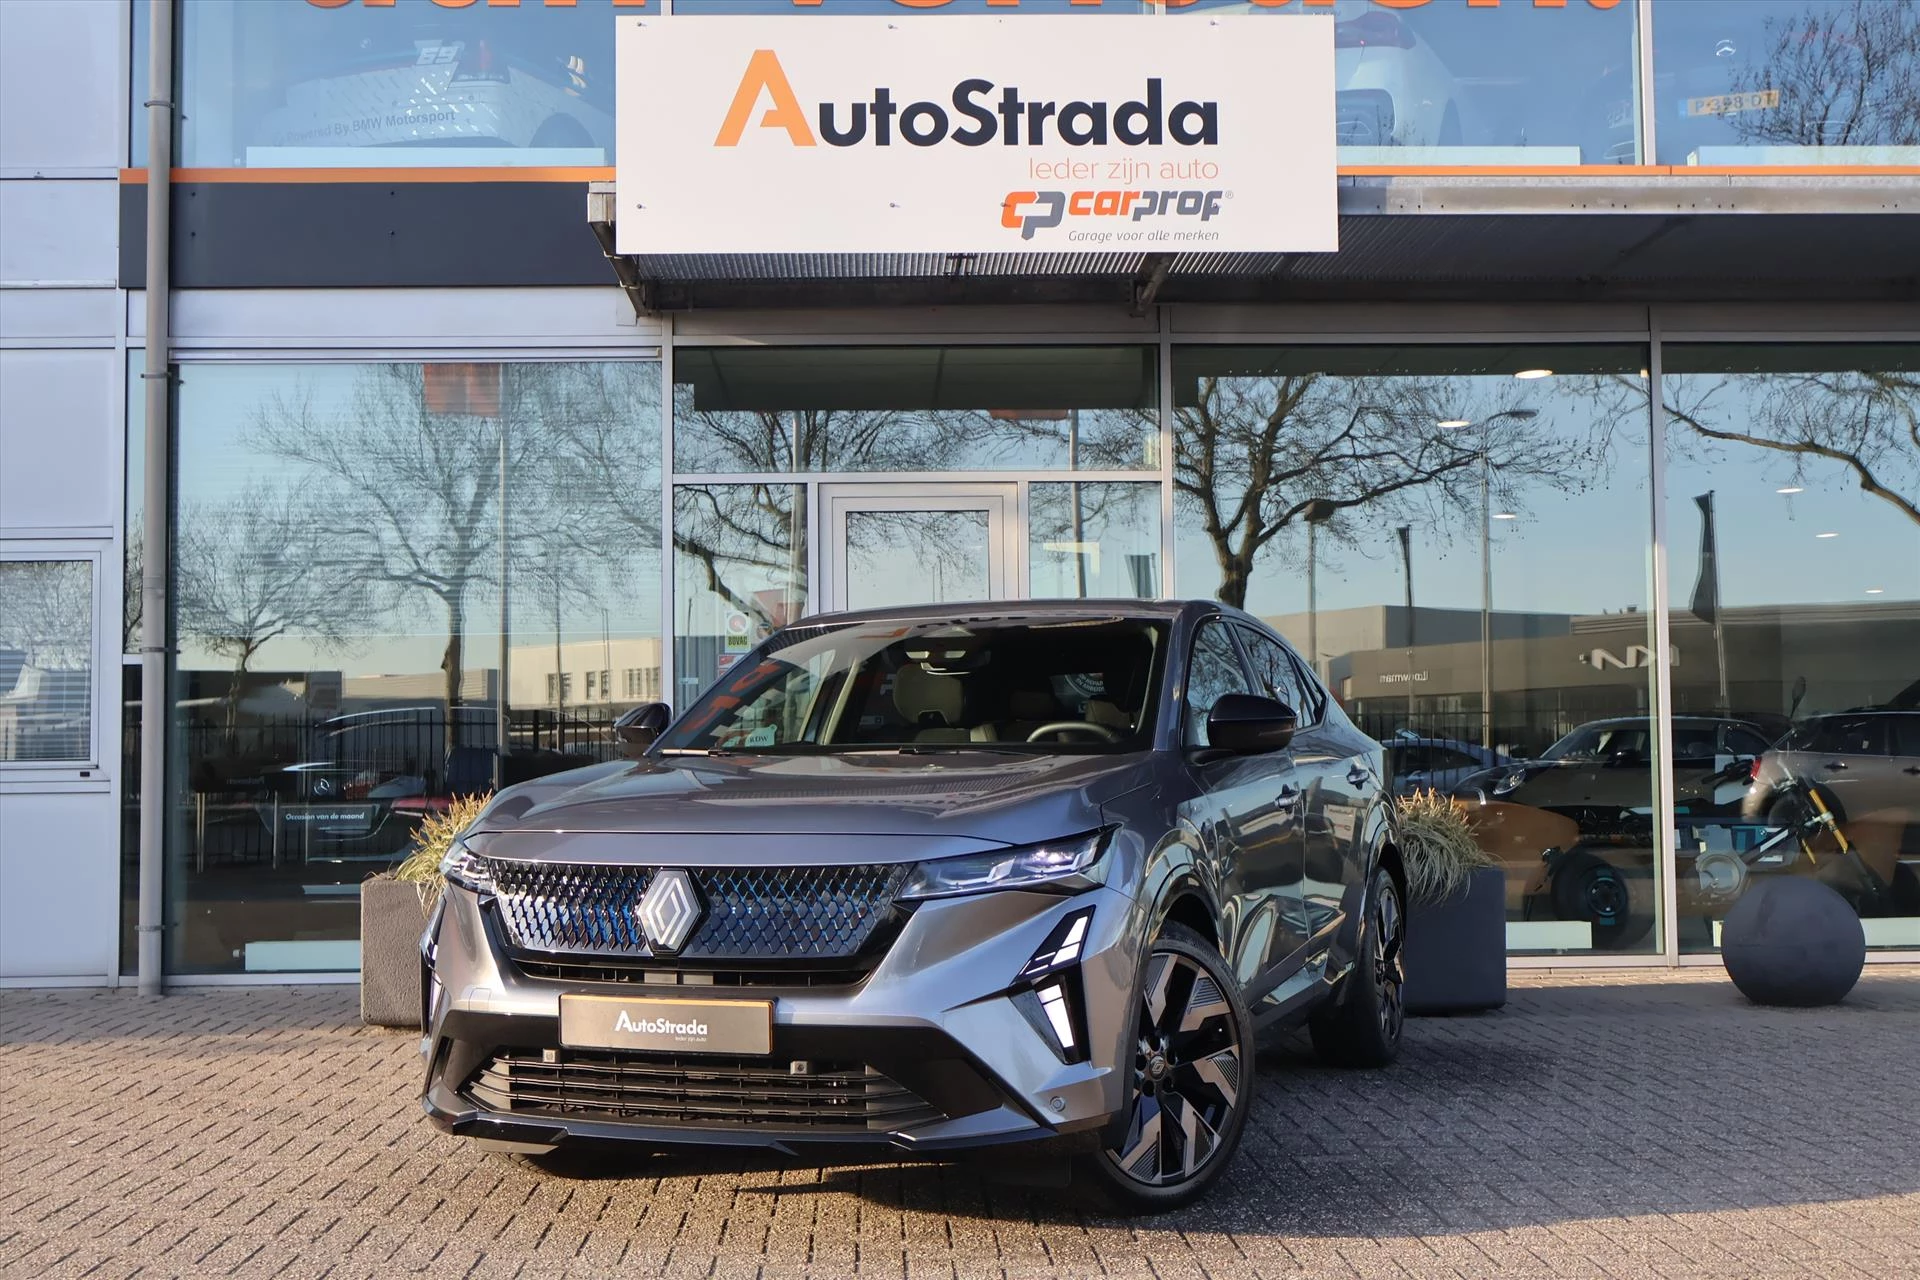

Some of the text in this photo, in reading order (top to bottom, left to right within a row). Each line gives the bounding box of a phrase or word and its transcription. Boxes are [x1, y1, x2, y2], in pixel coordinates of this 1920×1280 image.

[417, 46, 459, 65] 69
[713, 49, 1218, 147] AutoStrada
[334, 123, 349, 136] By
[352, 118, 382, 132] BMW
[385, 112, 456, 128] Motorsport
[1029, 157, 1219, 185] Ieder zijn auto
[1068, 190, 1223, 221] carprof
[1068, 230, 1219, 244] Garage voor alle merken
[728, 635, 748, 646] BOVAG
[285, 812, 315, 821] Occasion
[340, 812, 365, 820] maand
[614, 1010, 708, 1035] AutoStrada
